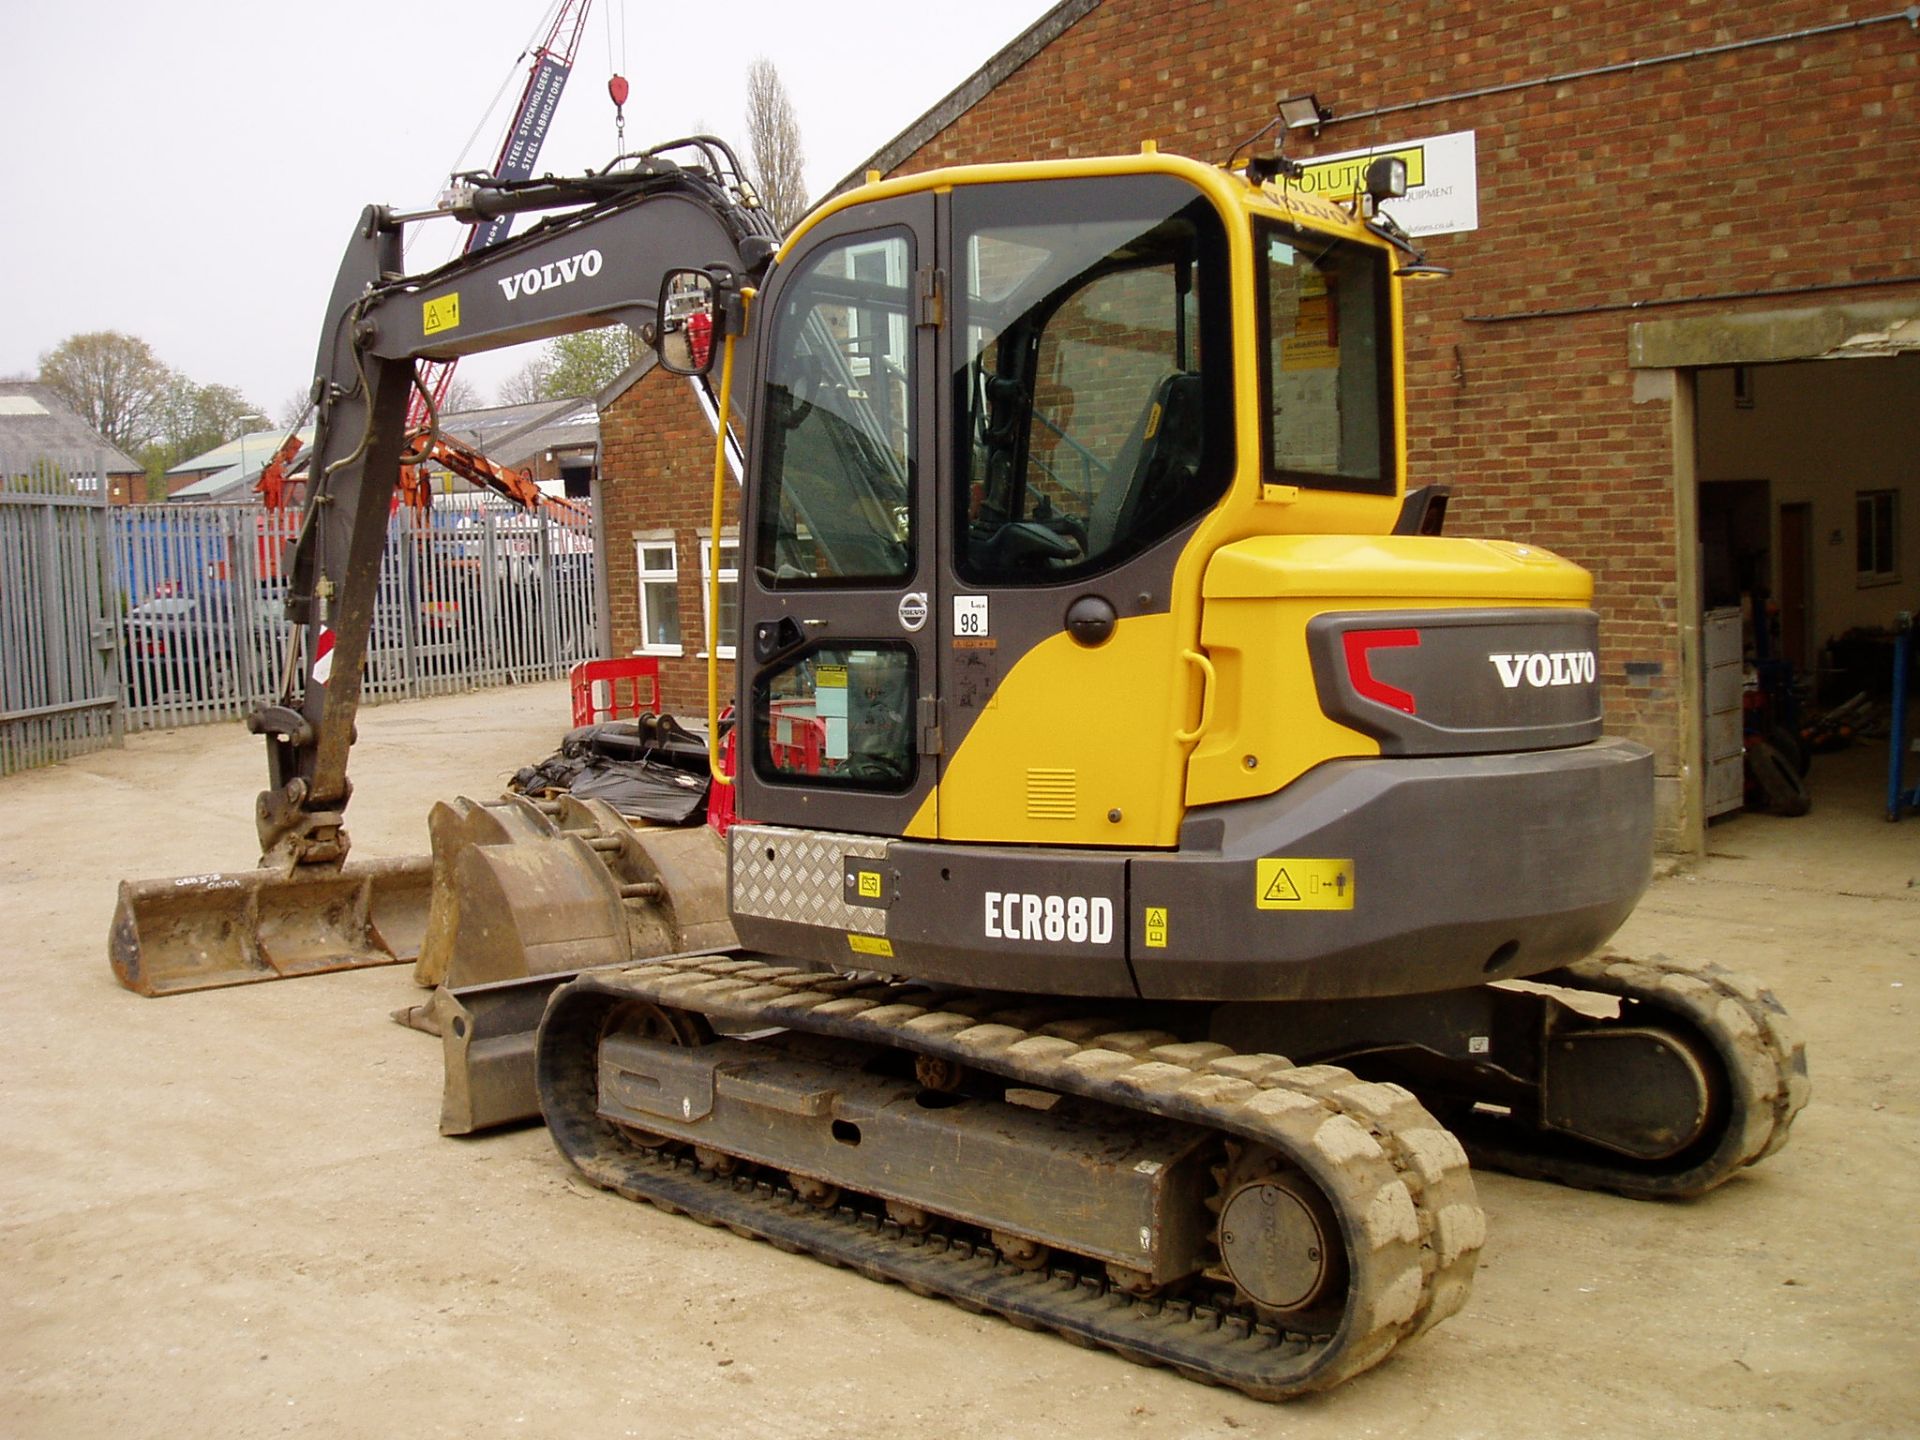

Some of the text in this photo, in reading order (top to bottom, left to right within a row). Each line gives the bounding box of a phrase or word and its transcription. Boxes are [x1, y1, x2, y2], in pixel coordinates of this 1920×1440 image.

[507, 66, 553, 168] STEEL STOCKHOLDERS
[521, 75, 564, 171] STEEL FABRICATORS
[1264, 192, 1348, 225] VOLVO
[498, 249, 603, 301] VOLVO
[899, 608, 926, 616] VOLVO
[961, 613, 978, 633] 98
[1489, 651, 1596, 688] VOLVO
[984, 891, 1114, 944] ECR88D
